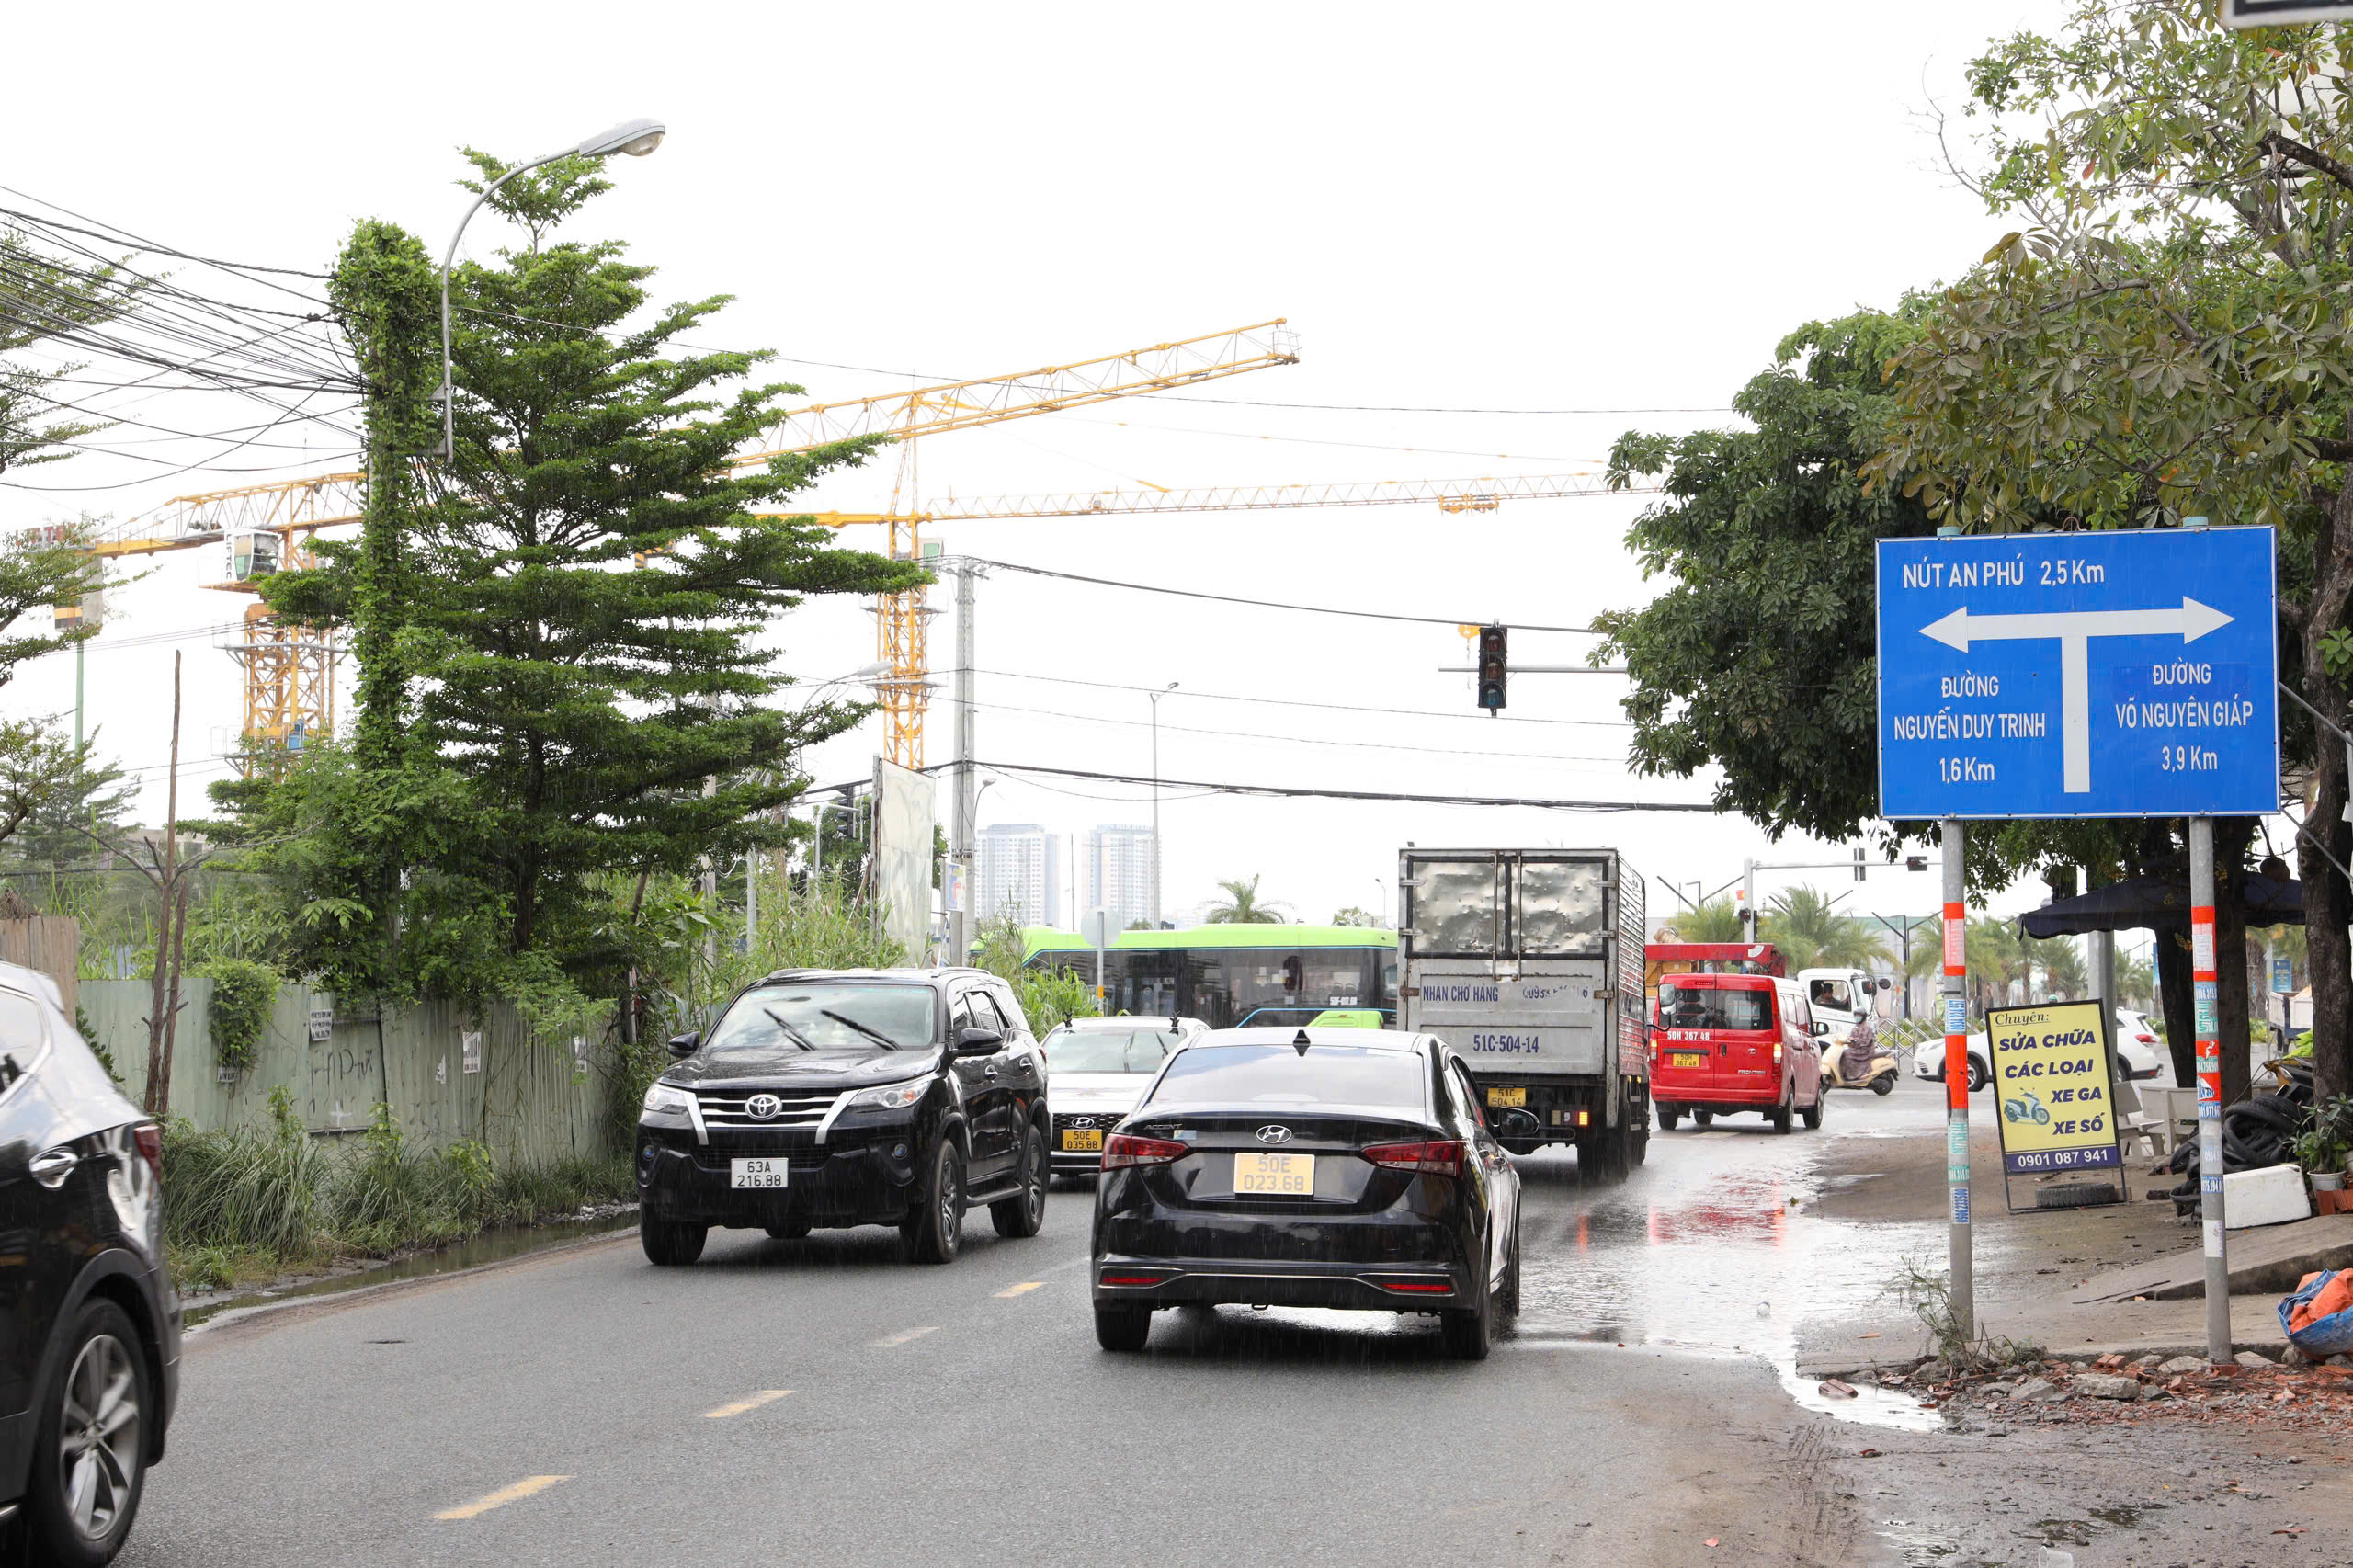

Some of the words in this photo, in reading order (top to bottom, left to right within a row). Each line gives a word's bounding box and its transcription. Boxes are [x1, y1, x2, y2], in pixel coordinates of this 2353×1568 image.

[1904, 556, 1943, 588] NÚT
[1949, 562, 1977, 587] AN
[1984, 553, 2024, 586] PHÚ
[2040, 561, 2067, 586] 2,5
[2072, 559, 2104, 583] Km
[2153, 657, 2211, 685] ĐƯỜNG
[1941, 669, 1999, 699] ĐƯỜNG
[2116, 697, 2138, 728] VÕ
[2142, 696, 2210, 727] NGUYÊN
[2212, 694, 2253, 726] GIÁP
[1894, 706, 1959, 741] NGUYỄN
[1962, 714, 1995, 739] DUY
[1998, 712, 2046, 738] TRINH
[2161, 746, 2186, 773] 3,9
[2190, 744, 2218, 770] Km
[1938, 758, 1961, 783] 1,6
[1964, 756, 1995, 781] Km
[1472, 983, 1499, 1002] HÀNG
[1995, 1013, 2051, 1028] Chuyên:
[1472, 1034, 1540, 1053] 51C-504-14
[1667, 1031, 1682, 1040] 50H
[1684, 1031, 1710, 1040] 367.48
[1998, 1032, 2037, 1051] SỬA
[2042, 1029, 2096, 1048] CHỮA
[2005, 1062, 2044, 1078] CÁC
[2048, 1060, 2094, 1076] LOẠI
[1498, 1088, 1516, 1097] 51C
[2051, 1090, 2074, 1103] XE
[2078, 1087, 2102, 1100] GA
[2052, 1121, 2075, 1135] XE
[2079, 1112, 2105, 1132] SỐ
[1074, 1131, 1090, 1140] 50E
[1067, 1141, 1097, 1149] 035.88
[747, 1161, 771, 1173] 63A
[1257, 1156, 1290, 1173] 50E
[2018, 1154, 2050, 1167] 0901
[2055, 1153, 2078, 1164] 087
[2085, 1151, 2108, 1162] 941
[737, 1174, 781, 1187] 216.88
[1244, 1175, 1304, 1191] 023.68
